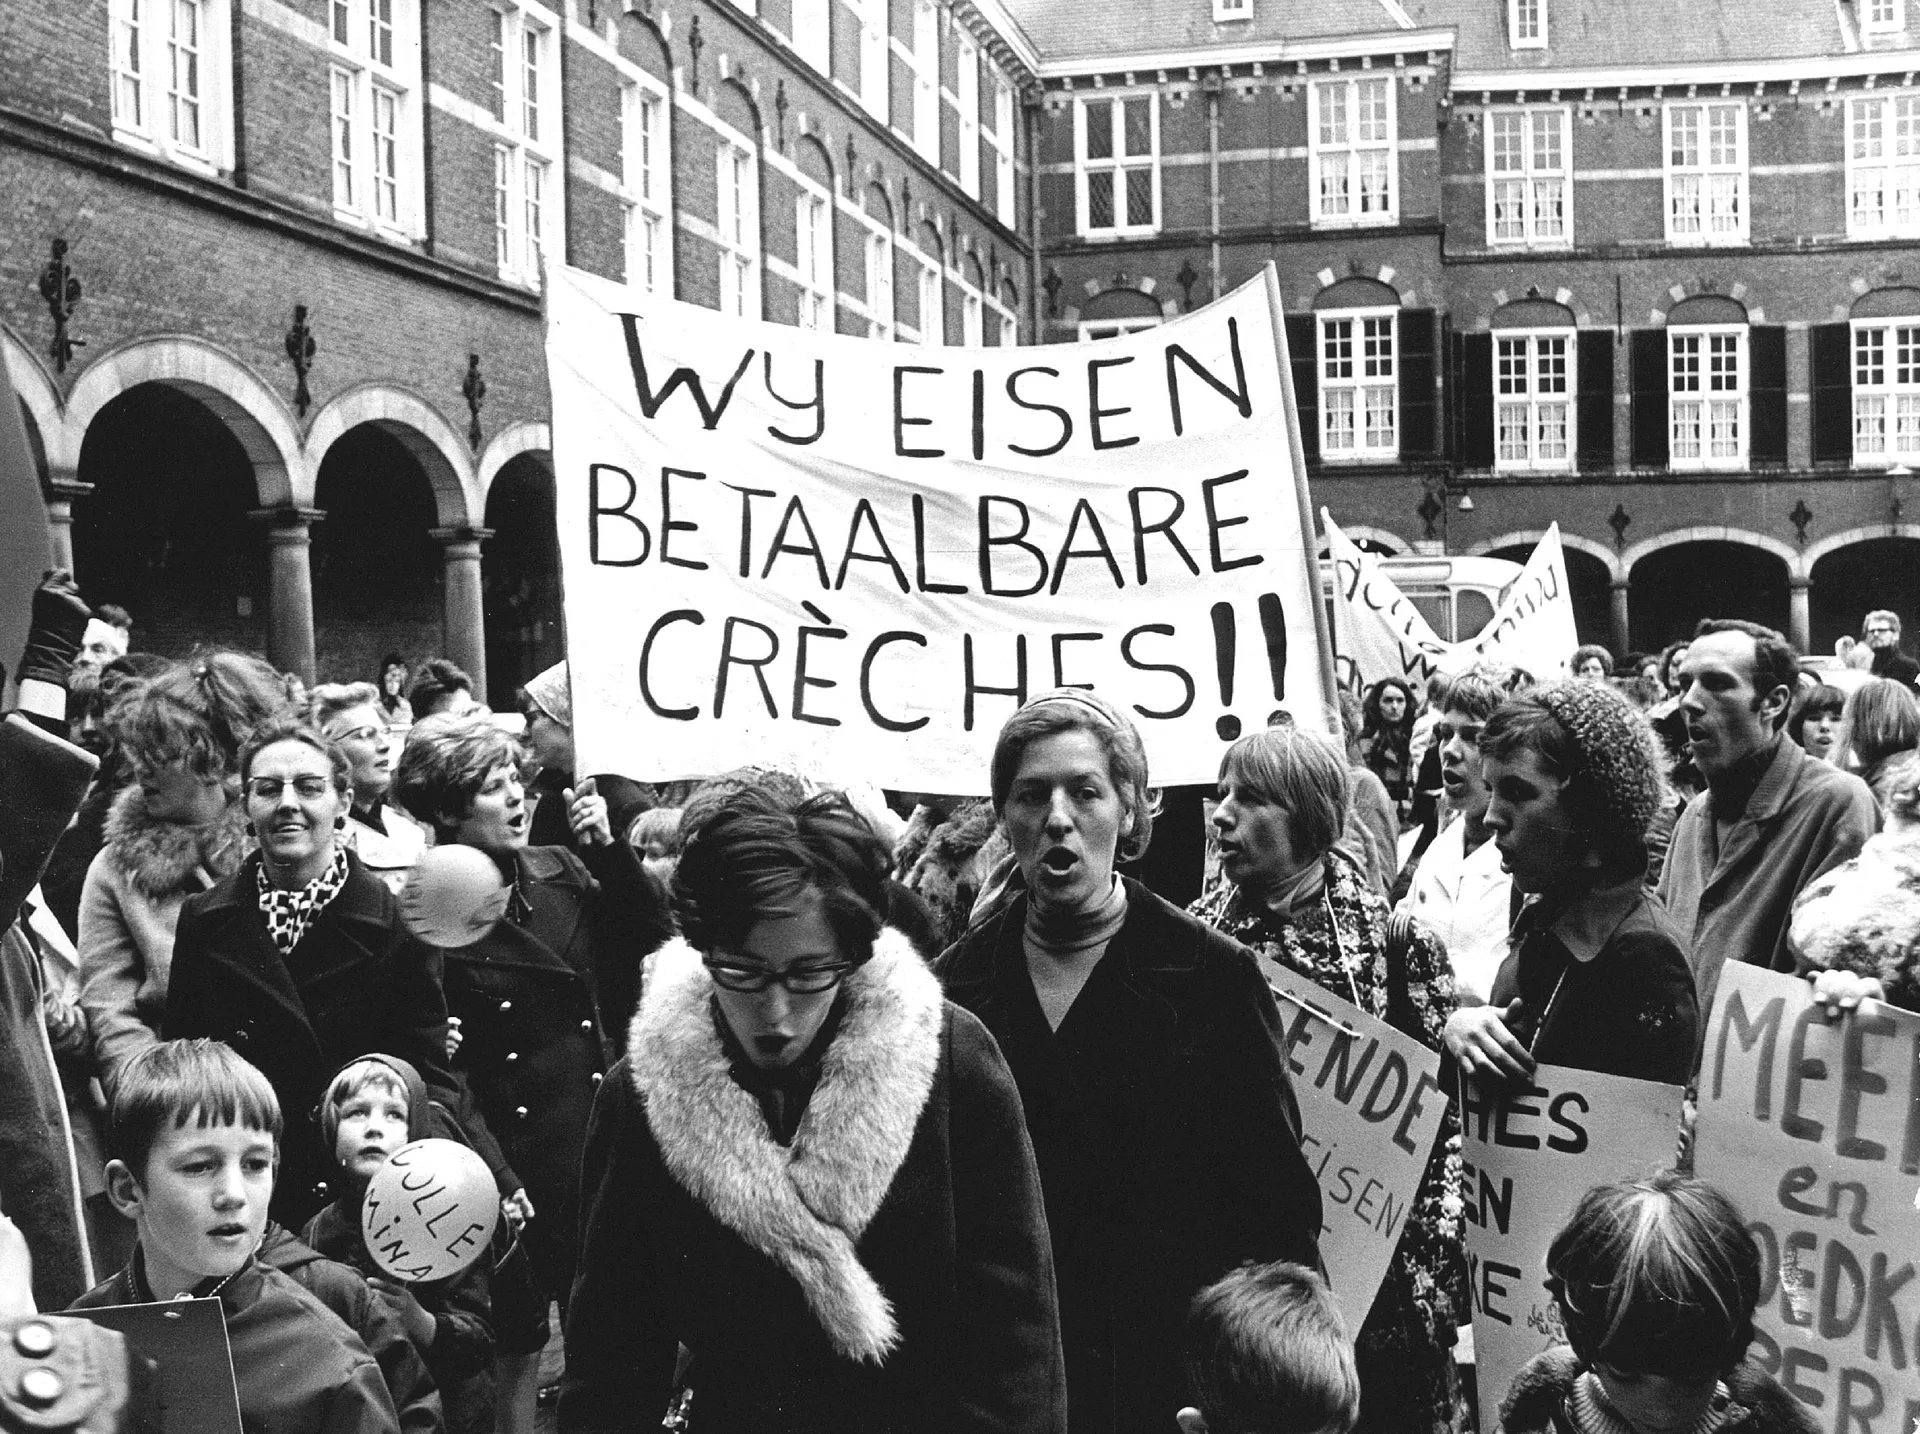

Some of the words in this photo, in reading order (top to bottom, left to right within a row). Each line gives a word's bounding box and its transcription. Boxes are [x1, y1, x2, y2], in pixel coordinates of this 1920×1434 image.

[893, 316, 1253, 460] EISEN
[588, 462, 1264, 596] BETAALBARE
[639, 591, 1294, 742] CRÈCHES!!
[1265, 976, 1440, 1156] ENDE
[1777, 1165, 1877, 1236] en
[1746, 1221, 1920, 1370] OEDK
